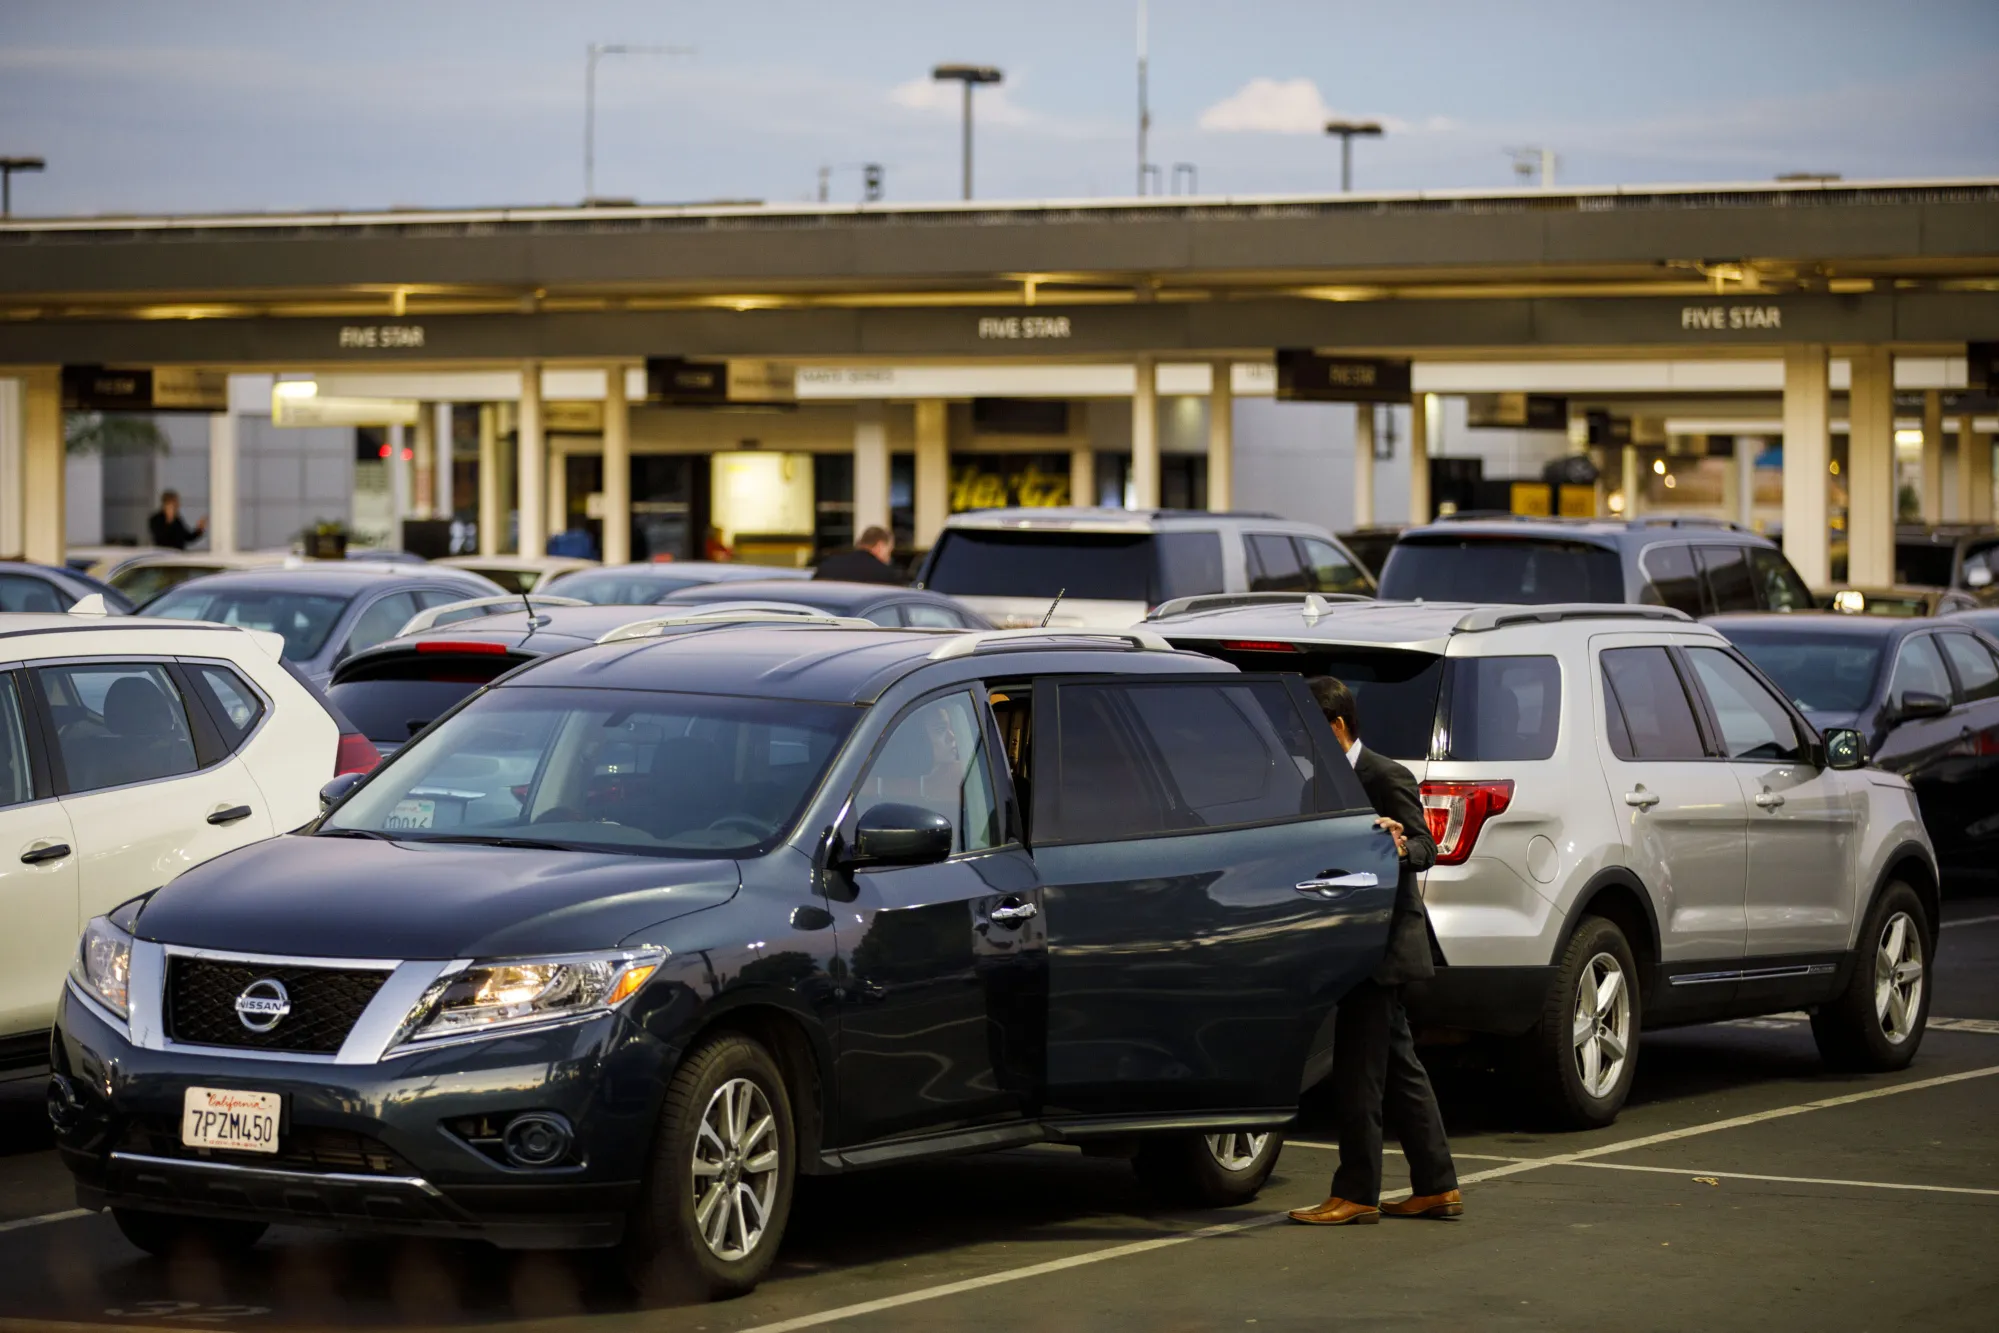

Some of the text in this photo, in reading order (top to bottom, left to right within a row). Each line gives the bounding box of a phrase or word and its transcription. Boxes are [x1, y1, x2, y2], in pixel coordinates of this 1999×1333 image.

[979, 316, 1071, 338] FIVE STAR
[1682, 306, 1781, 329] FIVE STAR
[340, 326, 425, 347] FIVE STAR
[240, 1001, 281, 1010] NISSAN
[208, 1094, 265, 1111] California
[192, 1109, 273, 1142] 7PZM450
